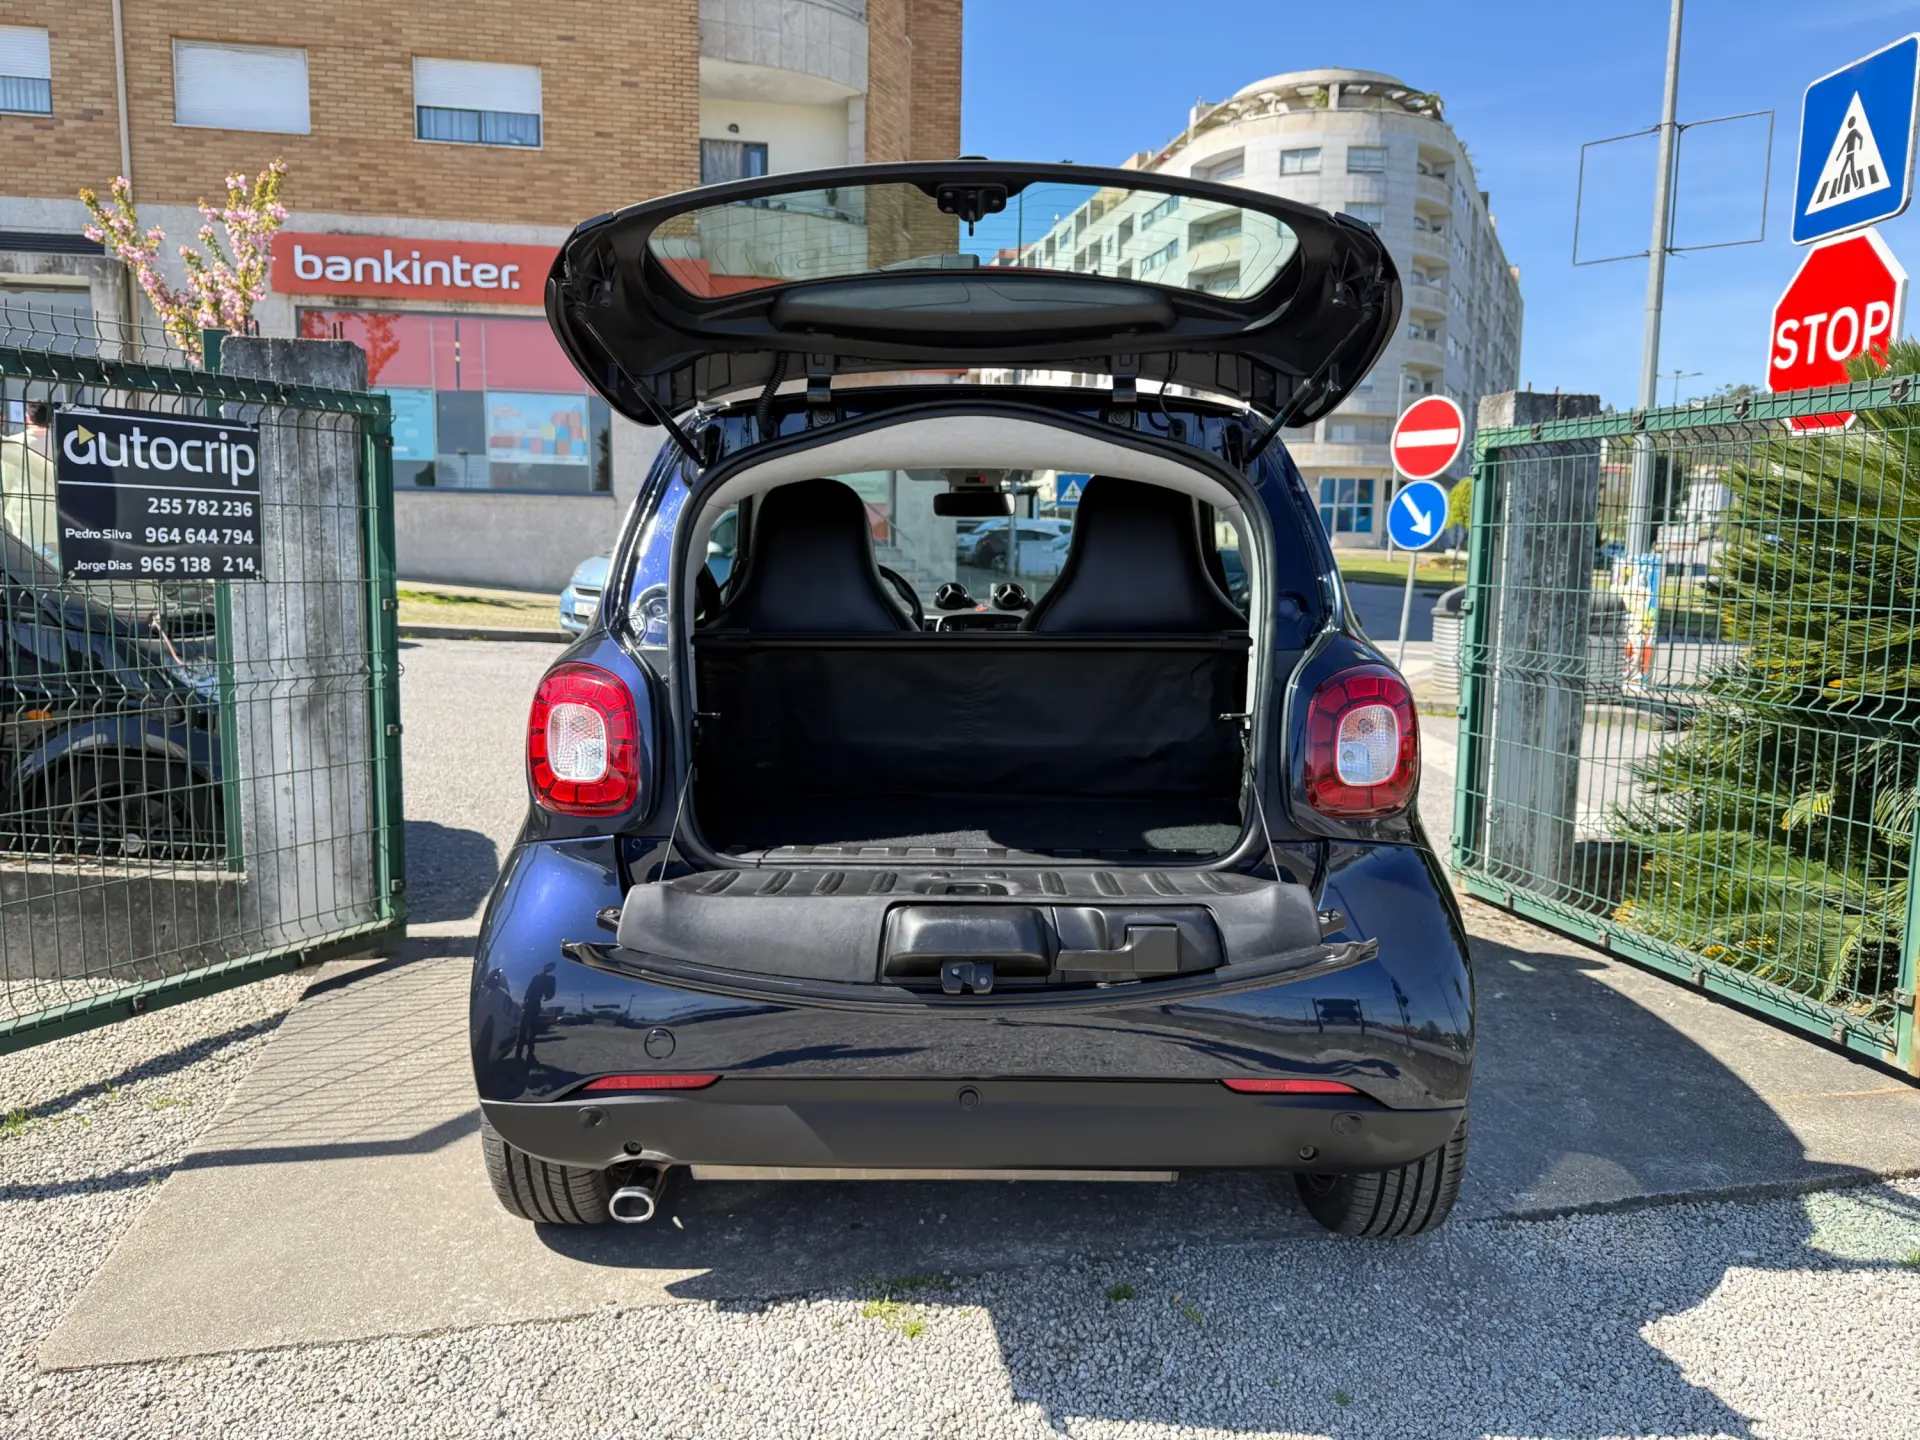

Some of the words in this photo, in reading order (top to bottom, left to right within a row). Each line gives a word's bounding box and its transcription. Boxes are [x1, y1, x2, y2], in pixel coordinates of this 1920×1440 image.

[293, 245, 521, 290] bankinter.
[1773, 300, 1891, 370] STOP
[63, 425, 256, 487] autocrip
[147, 497, 183, 515] 255
[186, 498, 219, 516] 782
[222, 500, 253, 517] 236
[65, 528, 101, 540] Pedro
[102, 529, 133, 540] Silva
[145, 527, 181, 544] 964
[184, 528, 219, 544] 644
[222, 529, 254, 545] 794
[74, 560, 106, 572] Jorge
[107, 560, 133, 571] Dias
[140, 556, 176, 573] 965
[180, 556, 211, 572] 138
[223, 557, 255, 573] 214
